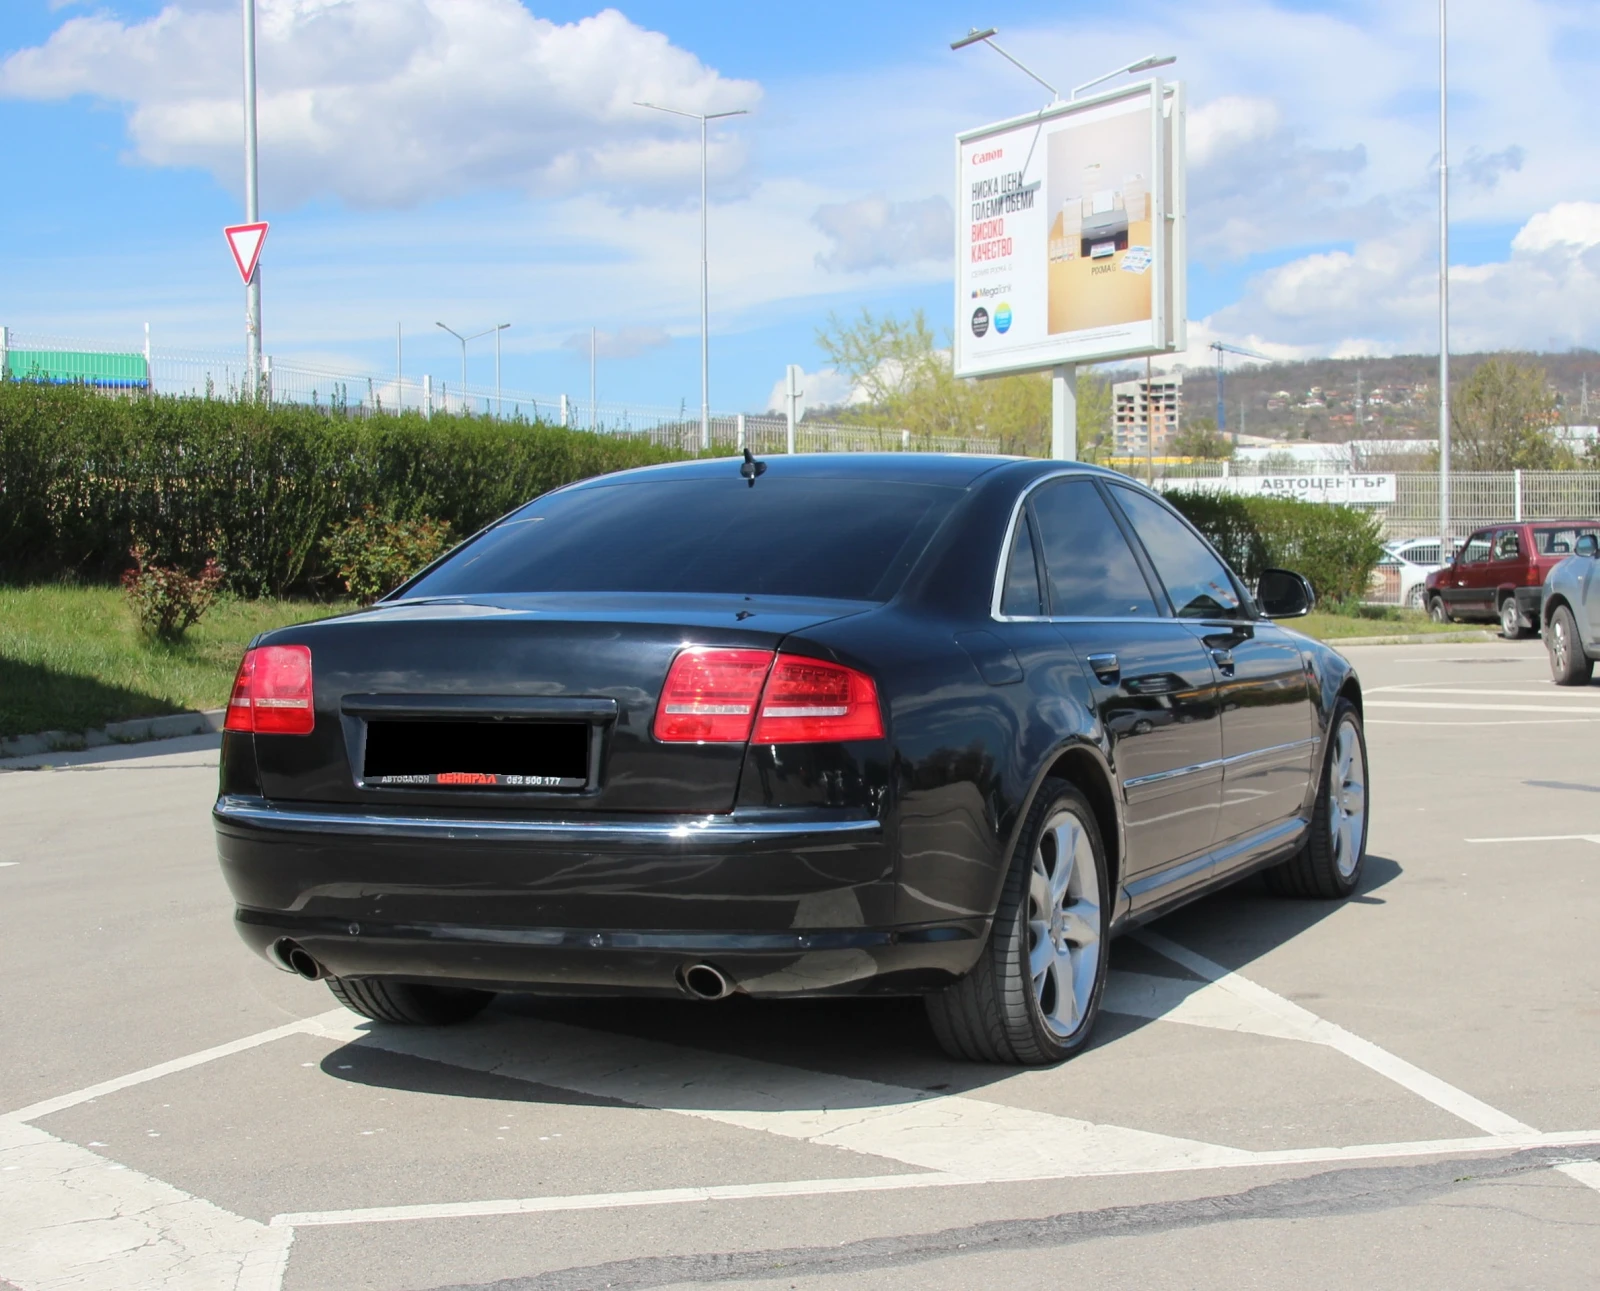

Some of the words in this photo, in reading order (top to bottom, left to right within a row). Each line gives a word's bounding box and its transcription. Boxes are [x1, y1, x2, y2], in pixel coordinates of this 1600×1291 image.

[972, 148, 1003, 166] Canon
[972, 178, 999, 201] НИСКА
[1001, 171, 1023, 195] ЦЕНА
[972, 197, 1004, 222] ГОЛЕМИ
[1006, 189, 1035, 214] ОБЕМИ
[972, 218, 1004, 242] ВИСОКО
[971, 237, 1013, 263] КАЧЕСТВО
[1091, 264, 1111, 275] PIXMA
[1261, 476, 1387, 490] АВТОЦЕНТЪР
[381, 775, 430, 784] АВТОСАЛОН
[437, 773, 497, 785] ЦЕНТРАЛ
[525, 776, 542, 785] 500
[544, 777, 561, 786] 177
